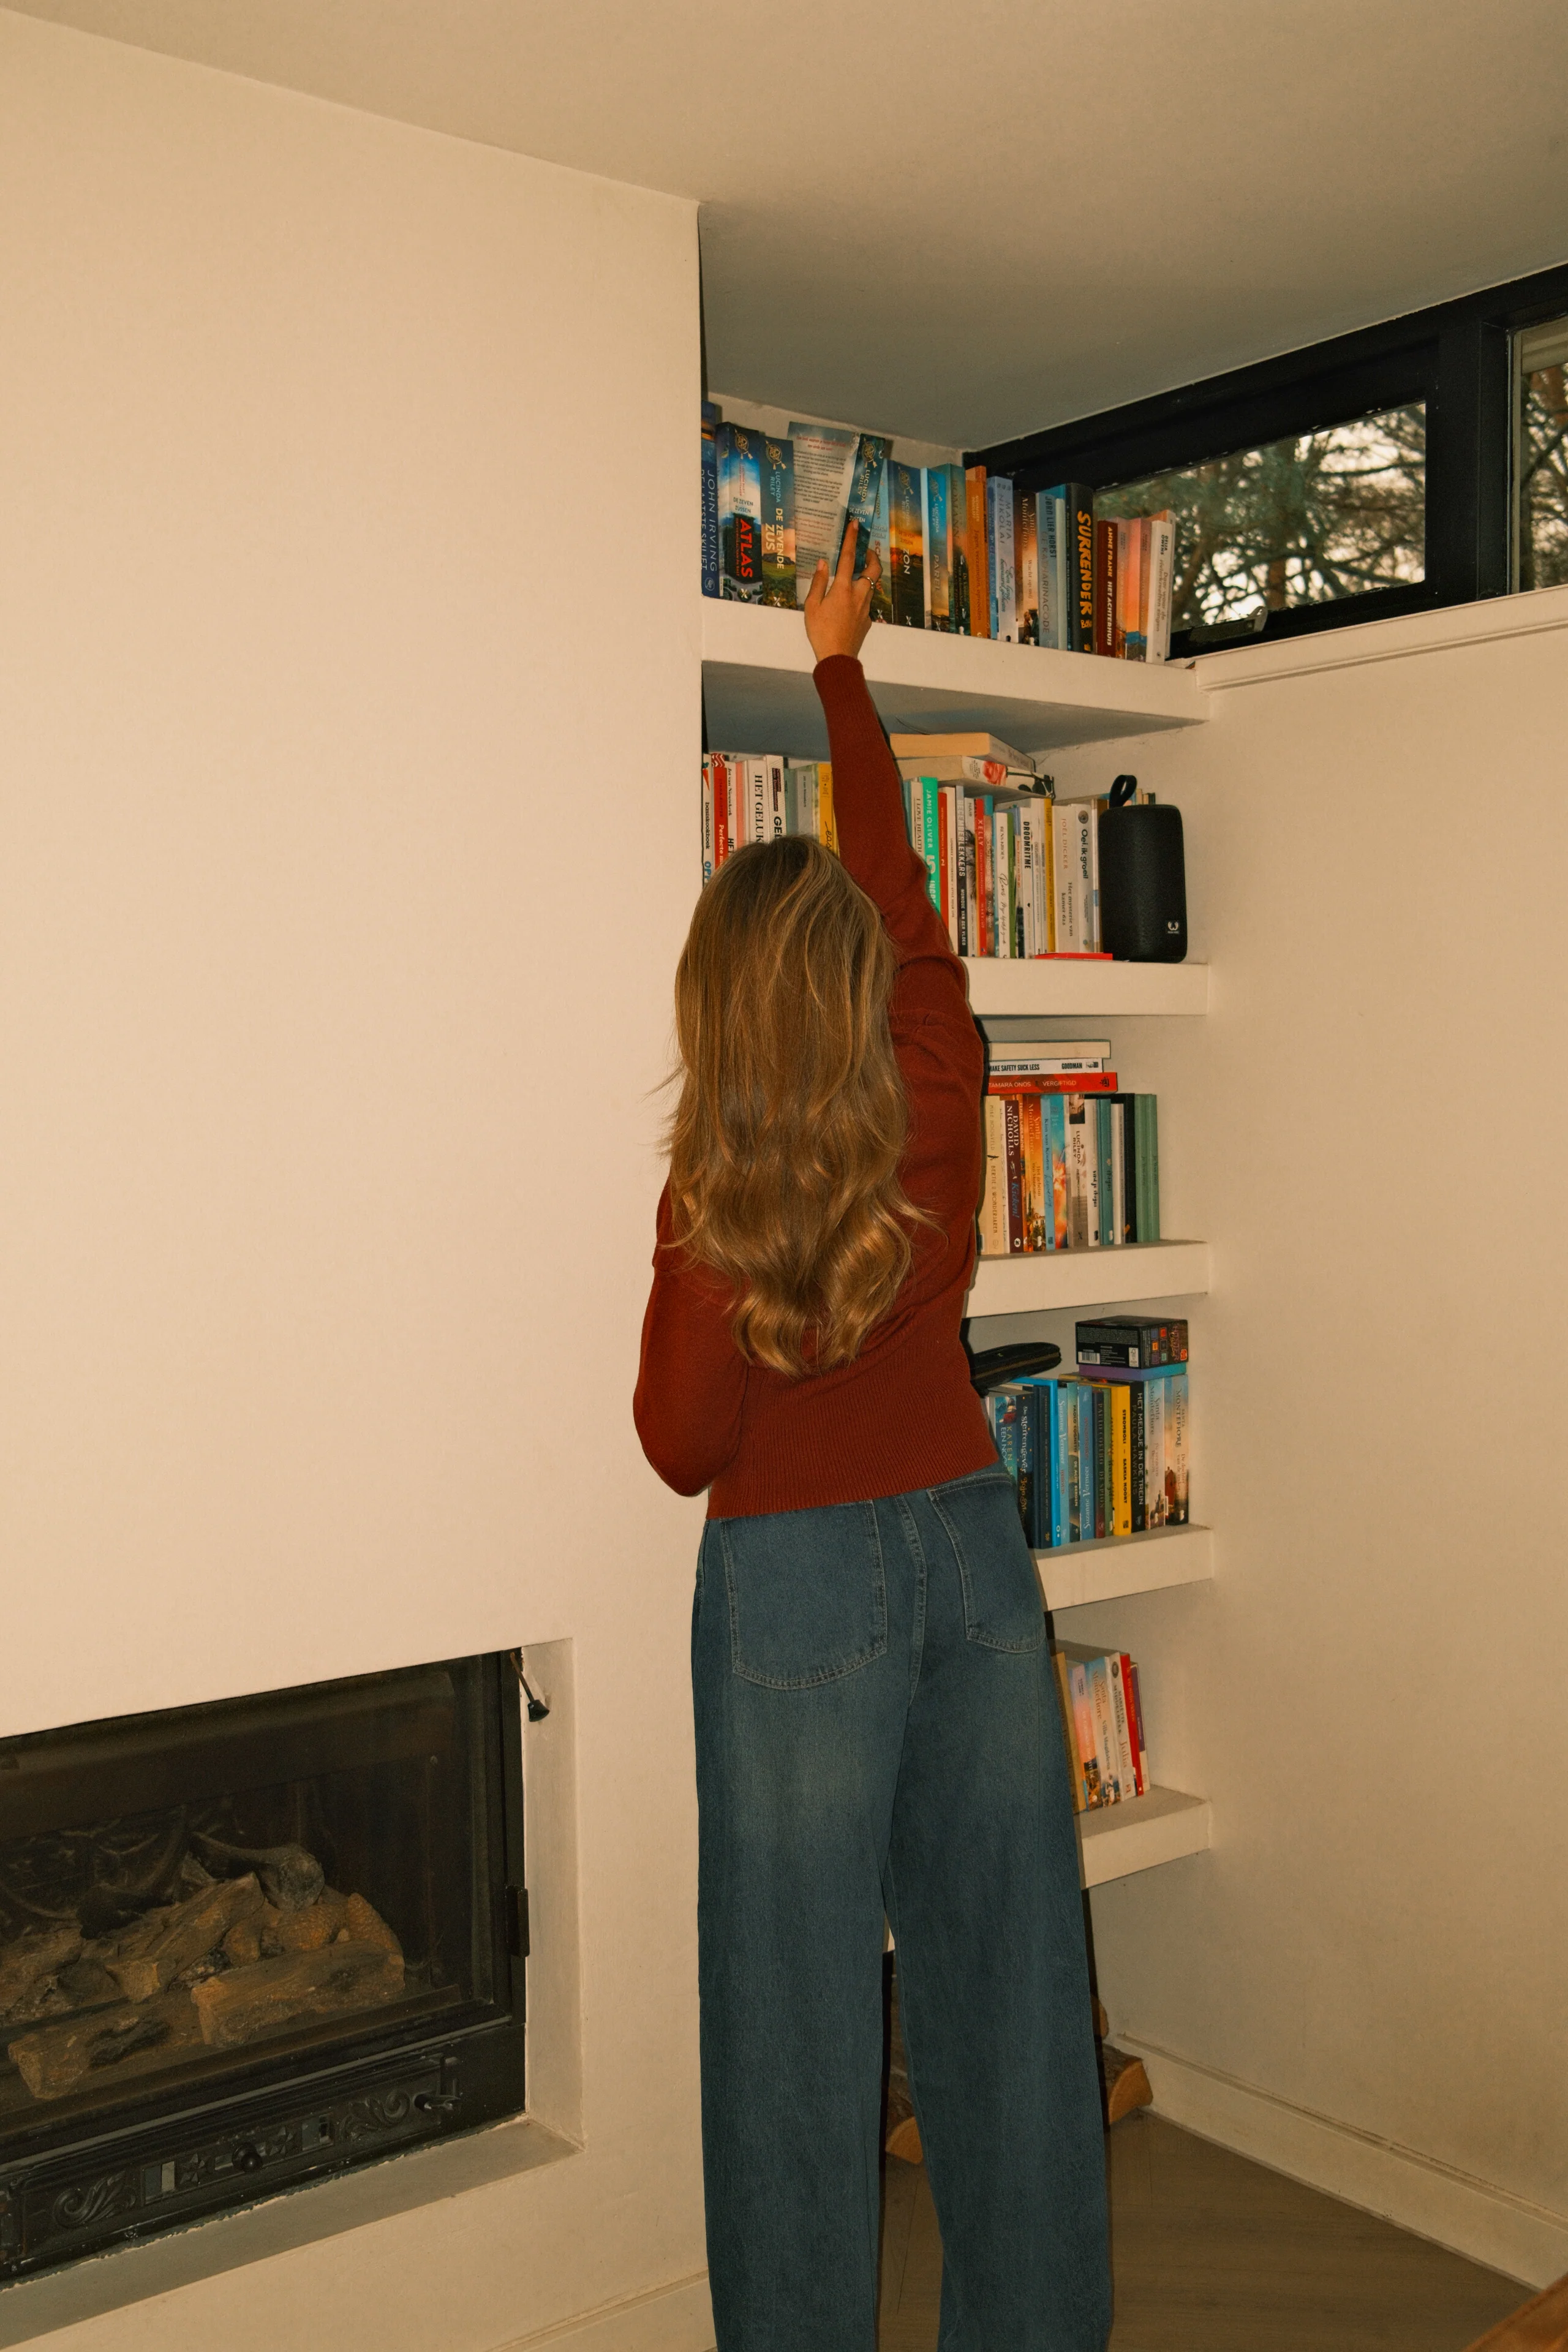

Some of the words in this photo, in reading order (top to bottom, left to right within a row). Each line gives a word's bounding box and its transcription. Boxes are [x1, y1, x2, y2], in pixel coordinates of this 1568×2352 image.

[861, 470, 870, 502] LUCINDA
[776, 508, 783, 522] DE
[766, 523, 775, 551] ZUS
[1041, 531, 1047, 545] DE
[741, 519, 753, 578] ATLAS
[1077, 511, 1093, 616] SURRENDER
[1027, 579, 1032, 588] op
[1161, 612, 1166, 620] de
[755, 775, 763, 800] HET
[755, 802, 764, 843] GELUK
[925, 855, 935, 874] 5
[998, 873, 1008, 897] Rens
[1023, 1406, 1028, 1415] De
[1020, 1416, 1028, 1473] sterrengever
[1138, 1450, 1143, 1460] IN
[1099, 1471, 1104, 1480] DE
[1138, 1464, 1144, 1476] DE
[1019, 1477, 1028, 1496] Jojo
[1082, 1466, 1091, 1497] Vermeer
[1093, 1670, 1101, 1719] Montefiore
